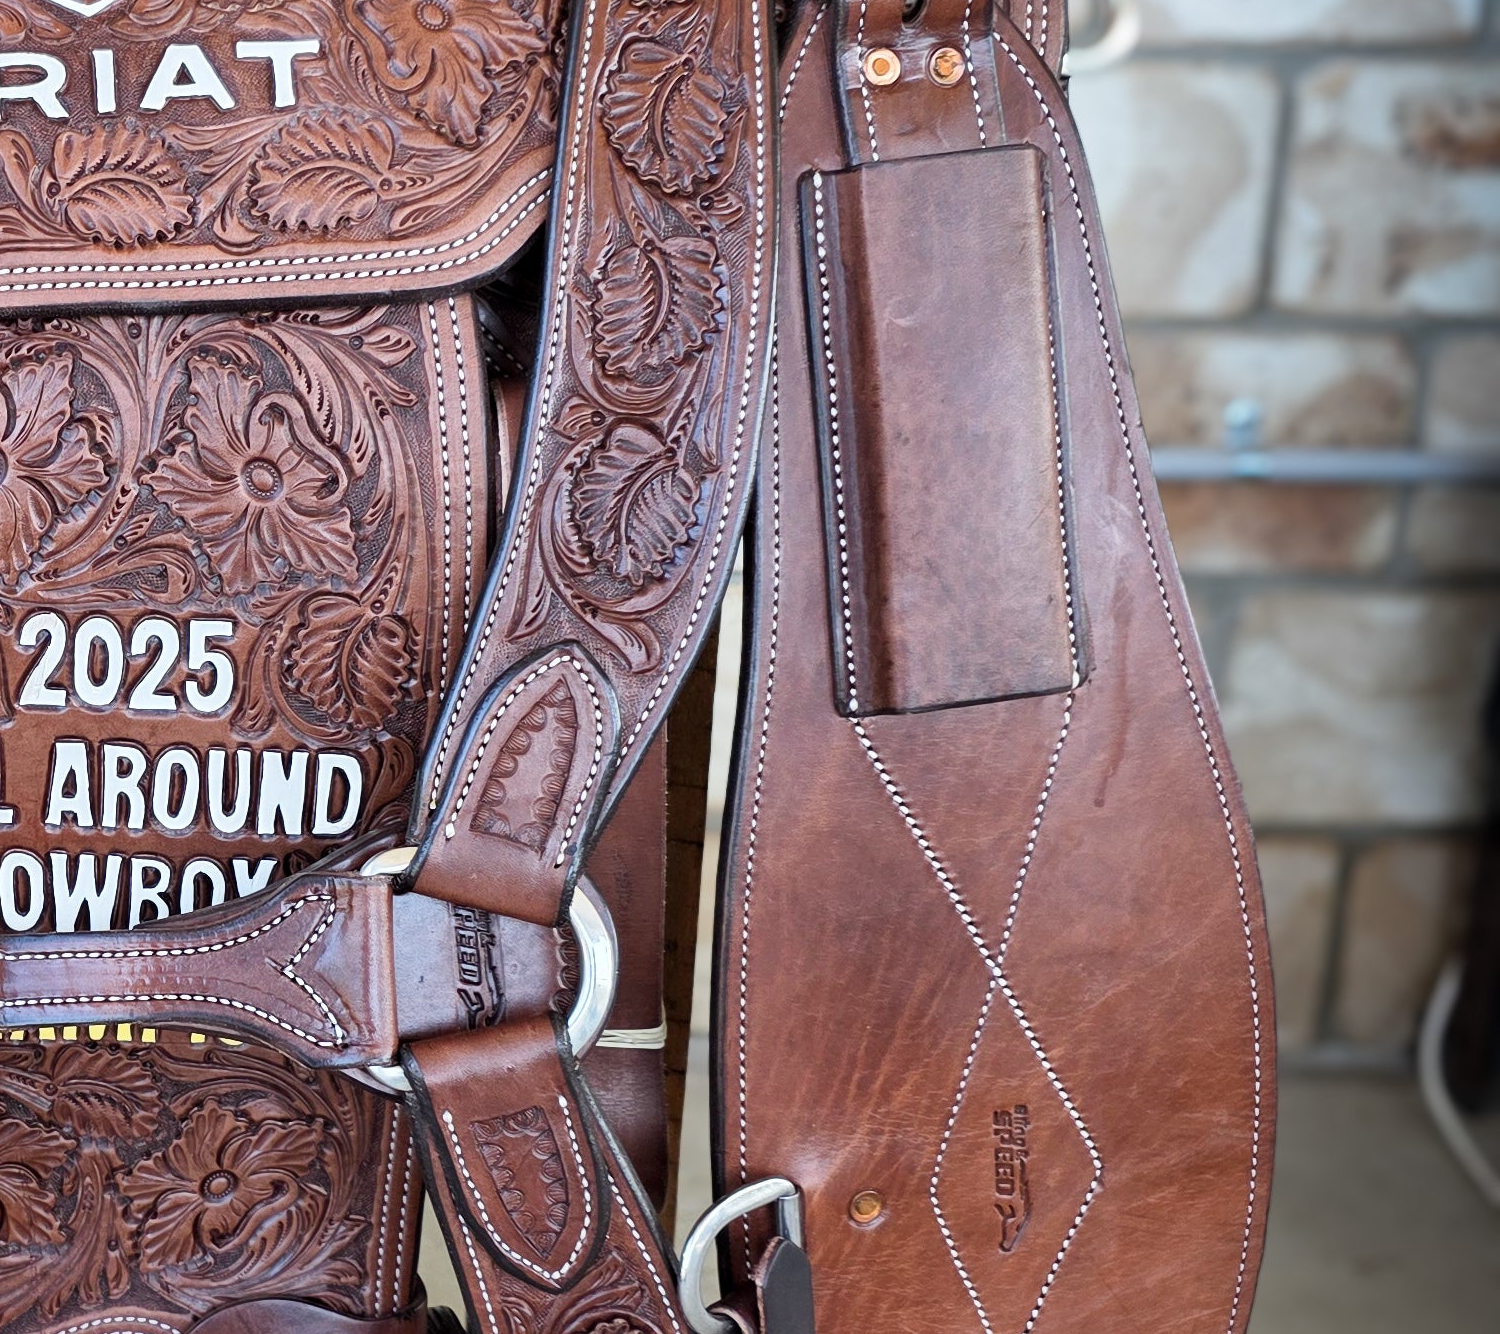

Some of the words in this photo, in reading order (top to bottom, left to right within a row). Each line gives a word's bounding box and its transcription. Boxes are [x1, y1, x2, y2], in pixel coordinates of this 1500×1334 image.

[16, 612, 235, 713] 2025
[44, 739, 363, 836] AROUND
[453, 903, 481, 986] PEED
[993, 1110, 1015, 1197] SPEED
